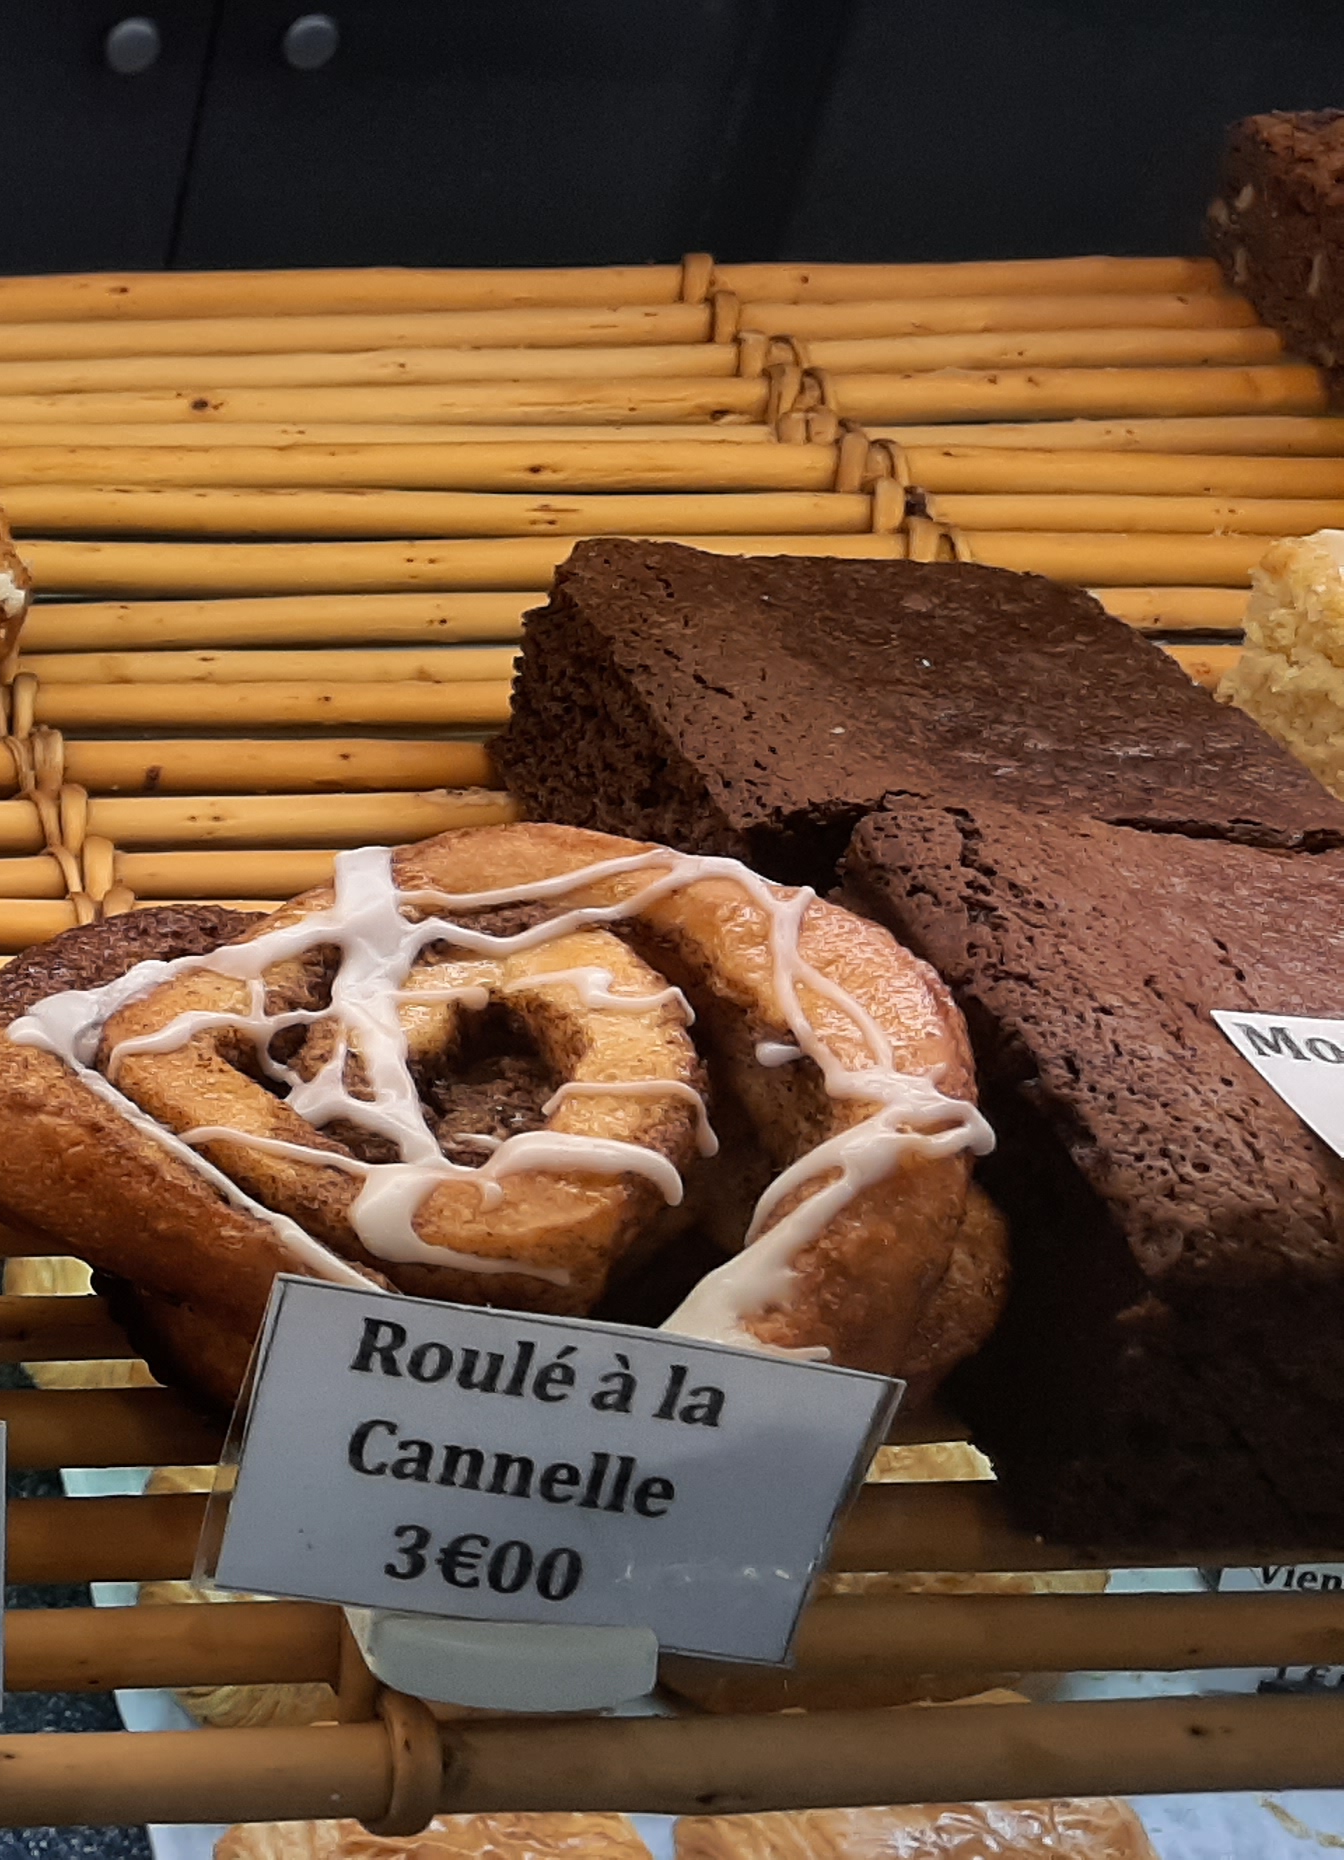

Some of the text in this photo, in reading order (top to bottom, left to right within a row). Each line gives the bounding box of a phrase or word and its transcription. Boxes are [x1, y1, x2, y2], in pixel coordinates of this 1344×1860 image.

[350, 1316, 727, 1428] Roulé à la
[348, 1419, 676, 1518] Cannelle
[384, 1524, 583, 1602] 3€00
